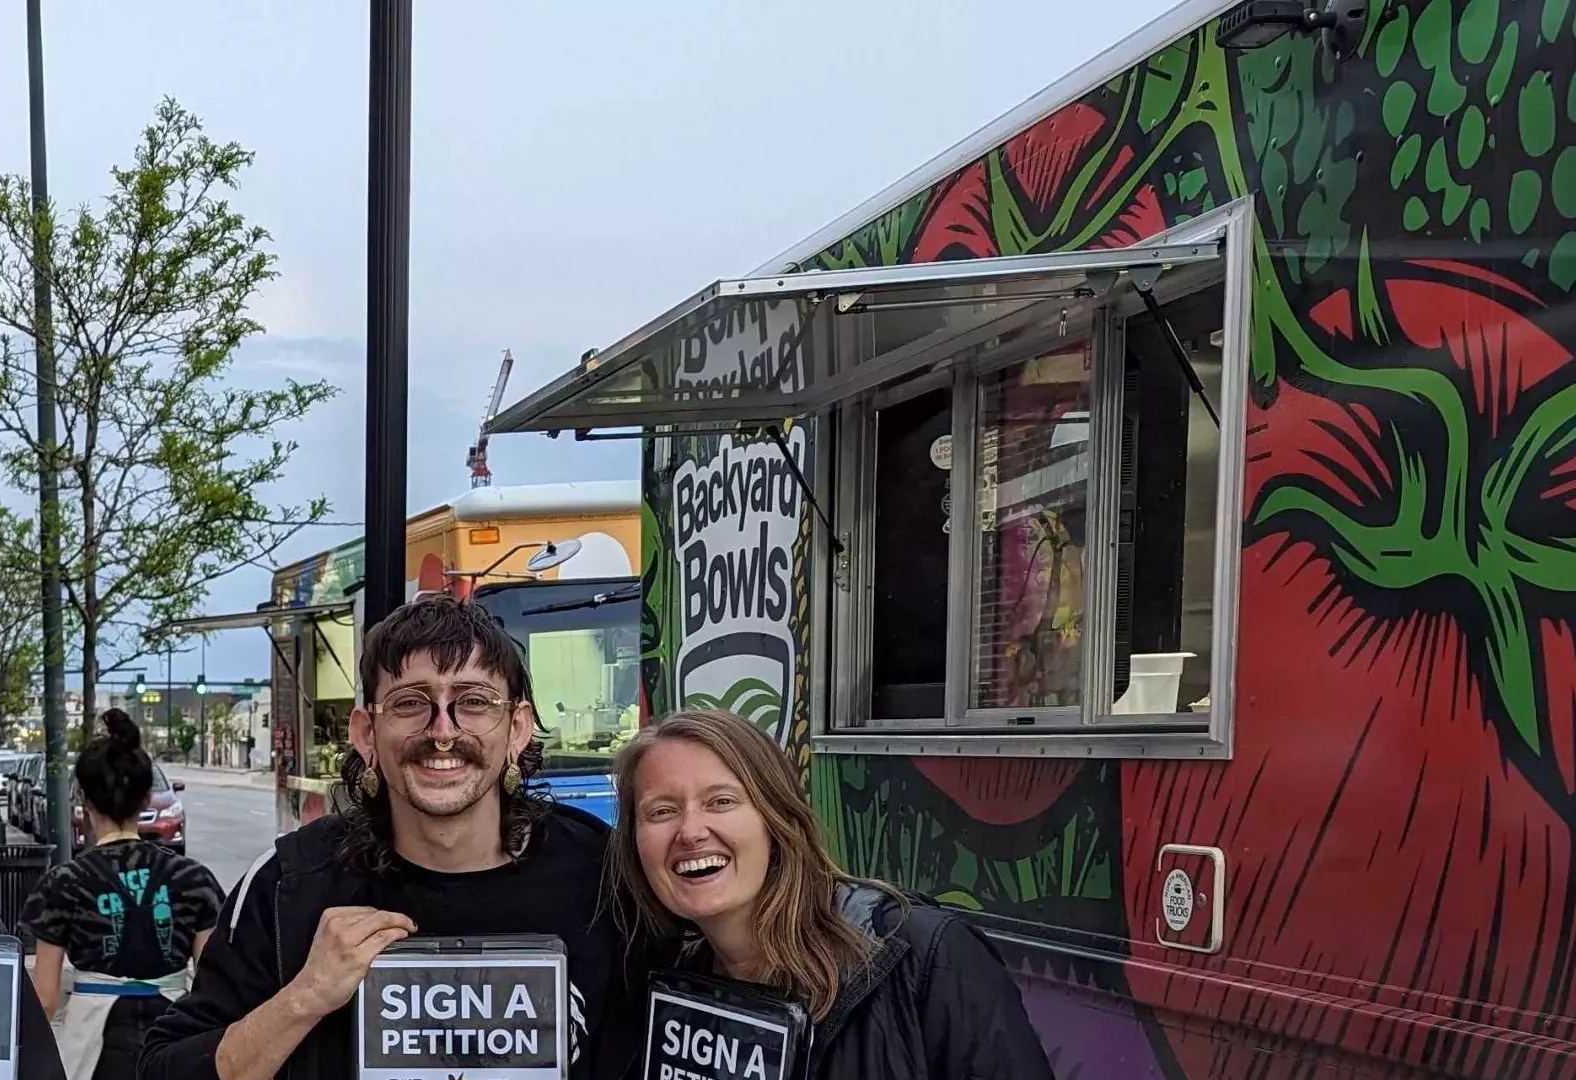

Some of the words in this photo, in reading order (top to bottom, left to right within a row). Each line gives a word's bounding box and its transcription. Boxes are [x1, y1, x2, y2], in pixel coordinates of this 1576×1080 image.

[677, 442, 800, 548] Backyard
[684, 521, 788, 637] Bowls
[1166, 904, 1189, 918] TRUCKS
[1169, 895, 1185, 905] FOOD
[380, 984, 492, 1020] SIGN
[503, 984, 537, 1019] A
[382, 1029, 538, 1055] PETITION
[662, 1020, 739, 1074] SIGN
